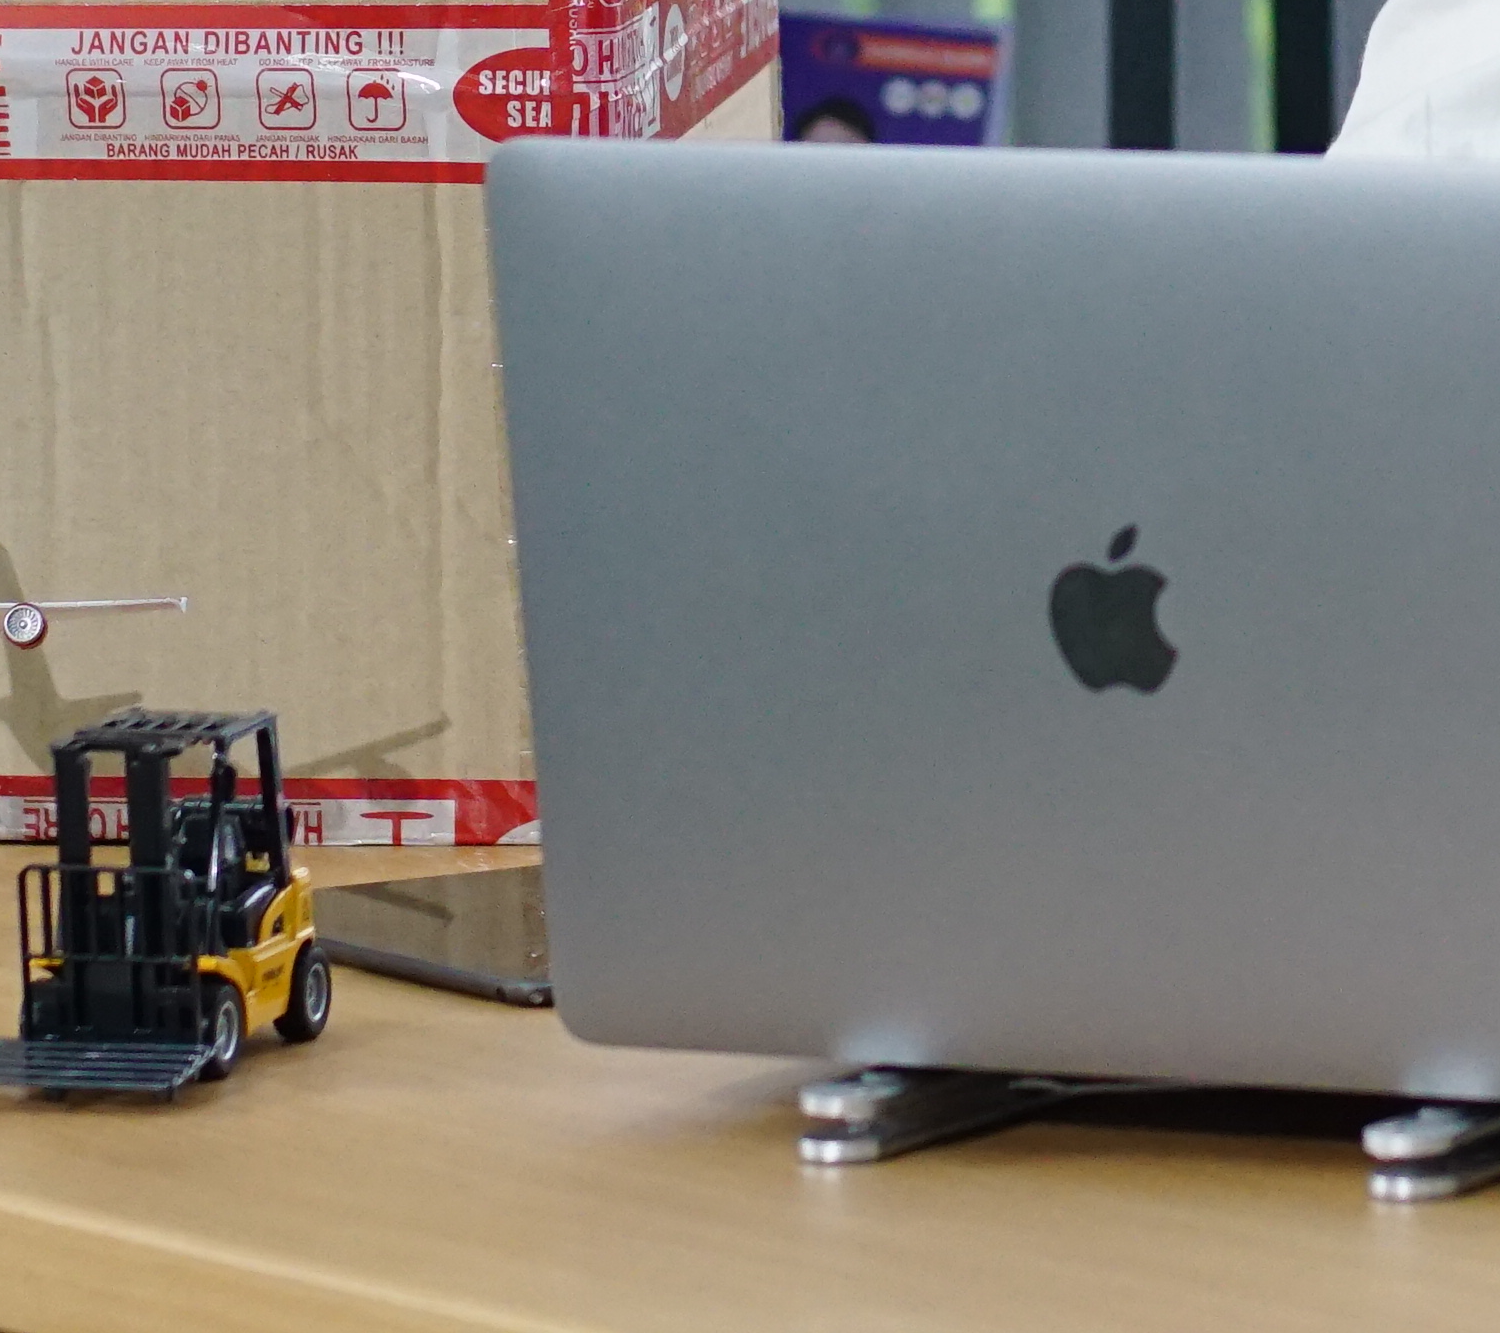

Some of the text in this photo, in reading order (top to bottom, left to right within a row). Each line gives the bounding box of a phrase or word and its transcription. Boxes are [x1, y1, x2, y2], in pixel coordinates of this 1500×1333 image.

[71, 30, 190, 56] JANGAN
[203, 30, 364, 56] DIBANTING
[106, 143, 170, 160] BARANG
[176, 143, 231, 160] MUDAH
[238, 143, 290, 160] PECAH
[306, 143, 358, 160] RUSAK
